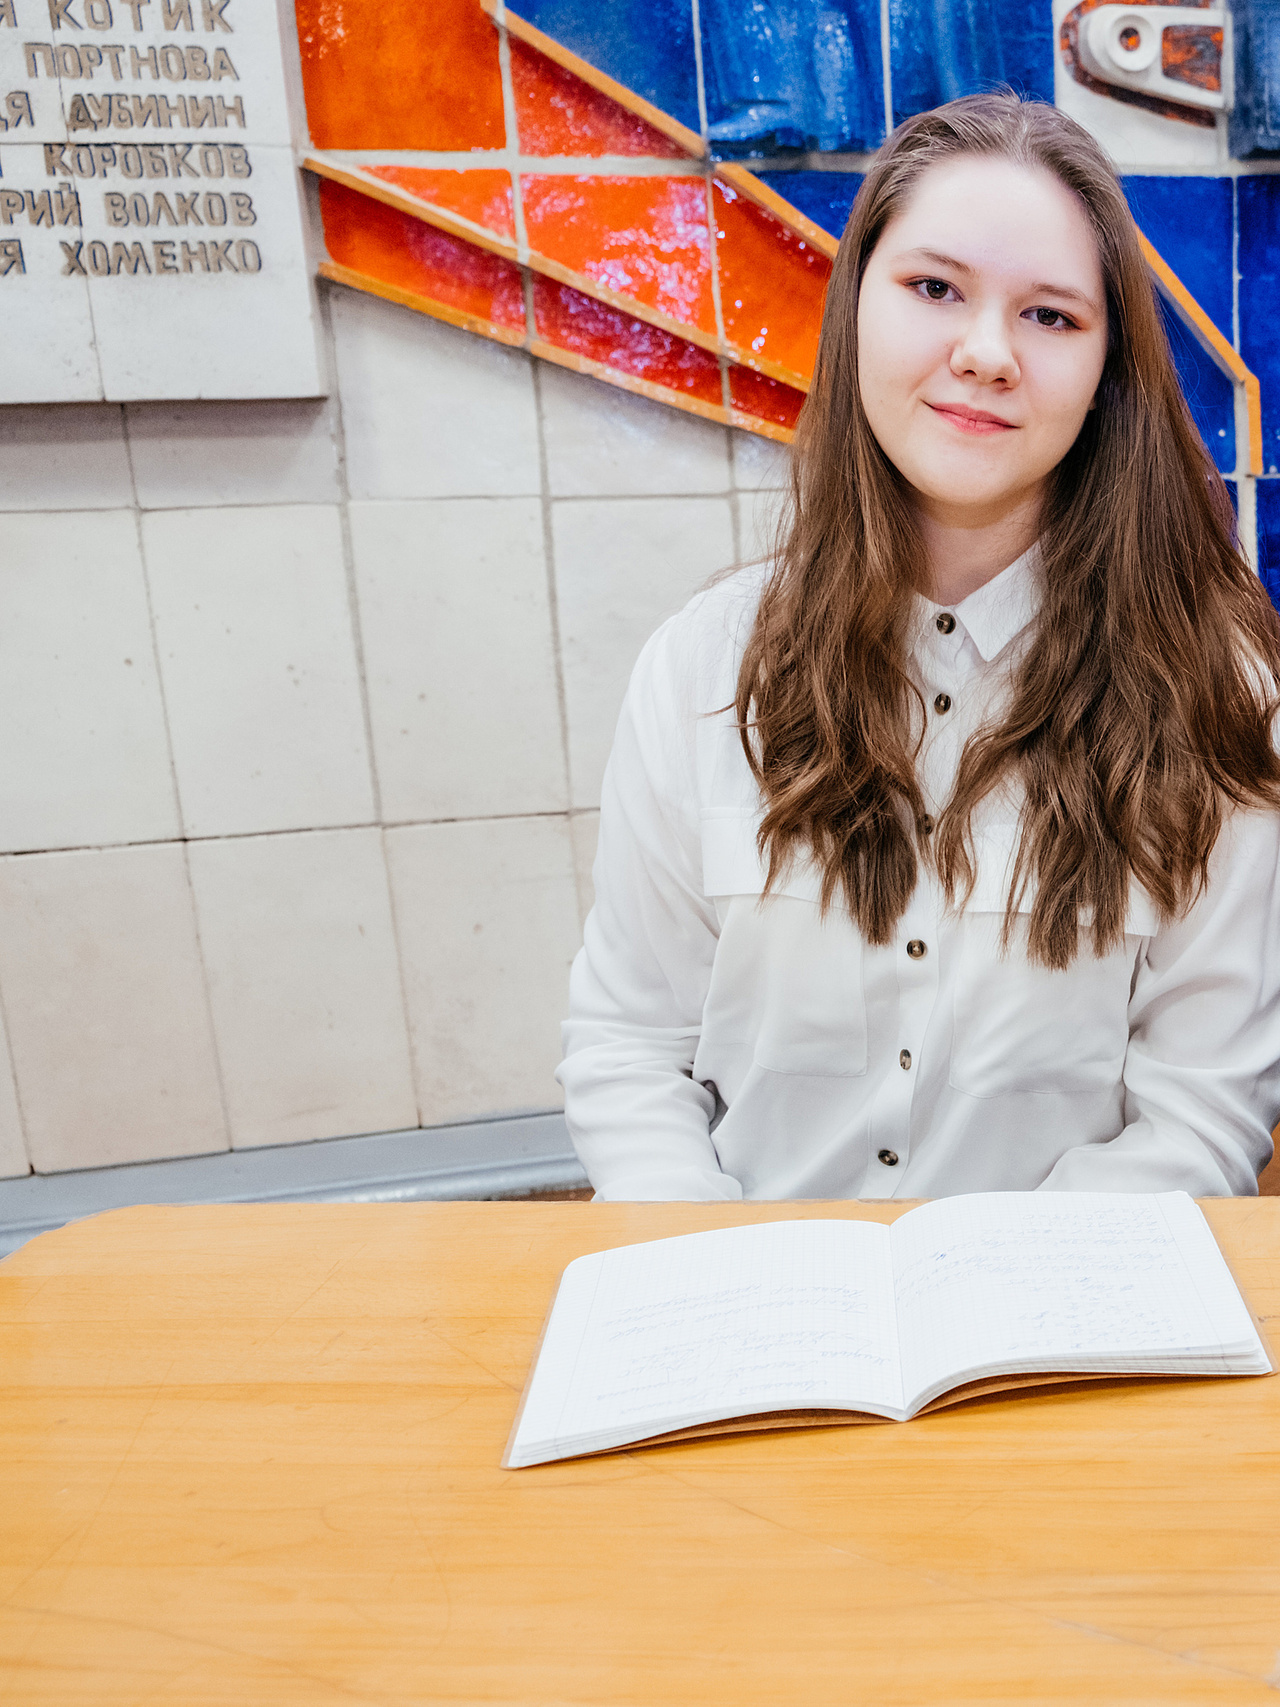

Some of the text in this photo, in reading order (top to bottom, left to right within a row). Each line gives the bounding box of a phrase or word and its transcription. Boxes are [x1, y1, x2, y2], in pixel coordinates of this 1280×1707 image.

[49, 0, 234, 32] КОТИК
[23, 42, 240, 81] ПОРТНОВА
[0, 91, 247, 131] Я ДУБИНИН
[43, 142, 253, 179] КОРОБКОВ
[0, 182, 257, 228] РИЙ ВОЛКОВ
[59, 239, 263, 276] ХОМЕНКО
